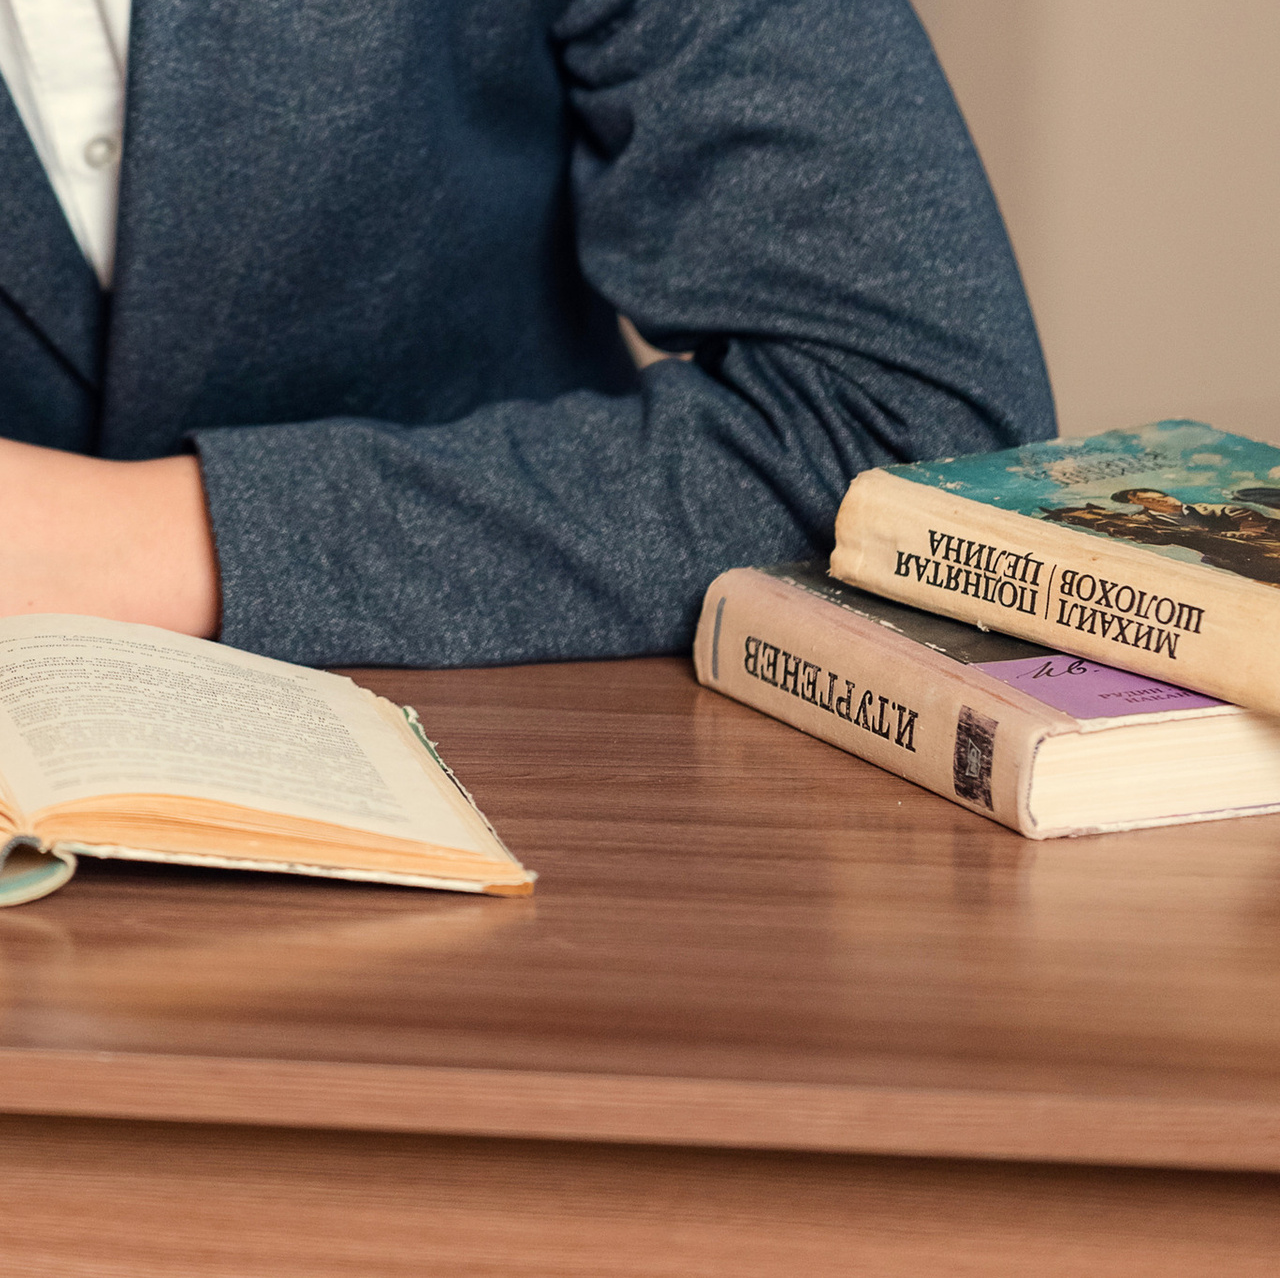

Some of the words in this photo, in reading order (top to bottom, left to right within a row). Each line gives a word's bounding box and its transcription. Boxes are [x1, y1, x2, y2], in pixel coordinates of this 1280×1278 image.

[894, 550, 1038, 615] ПОДНЯТАЯ
[928, 529, 1045, 586] ЦЕЛИНА
[1056, 600, 1181, 659] МИХАИЛ
[1060, 568, 1206, 635] ШОЛОХОВ
[1124, 691, 1193, 703] НАКАН
